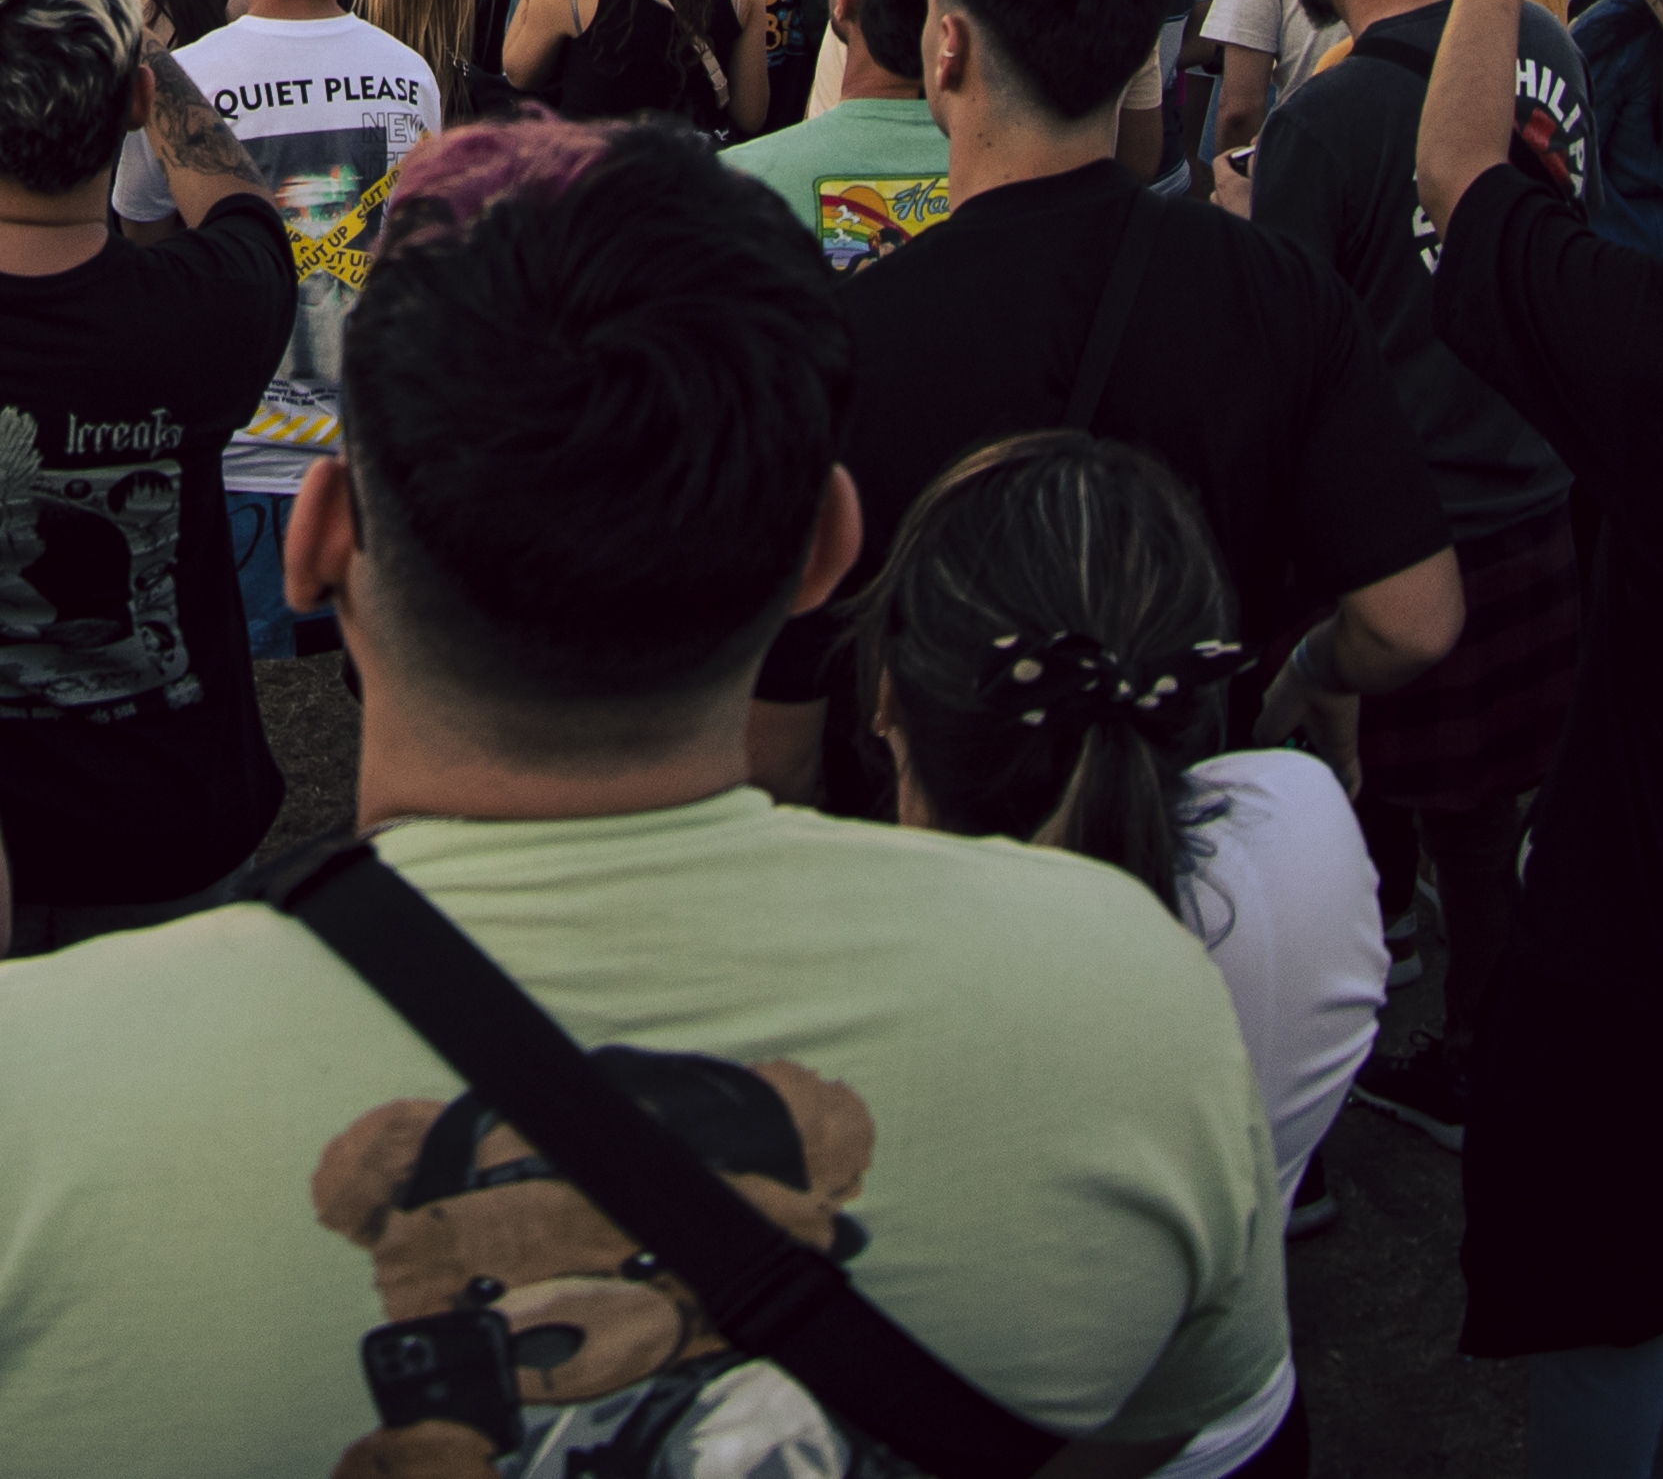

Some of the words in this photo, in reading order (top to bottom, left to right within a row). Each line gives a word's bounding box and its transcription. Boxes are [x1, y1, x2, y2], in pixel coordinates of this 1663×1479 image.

[215, 79, 313, 120] QUIET
[324, 75, 420, 106] PLEASE
[893, 176, 950, 223] Ha
